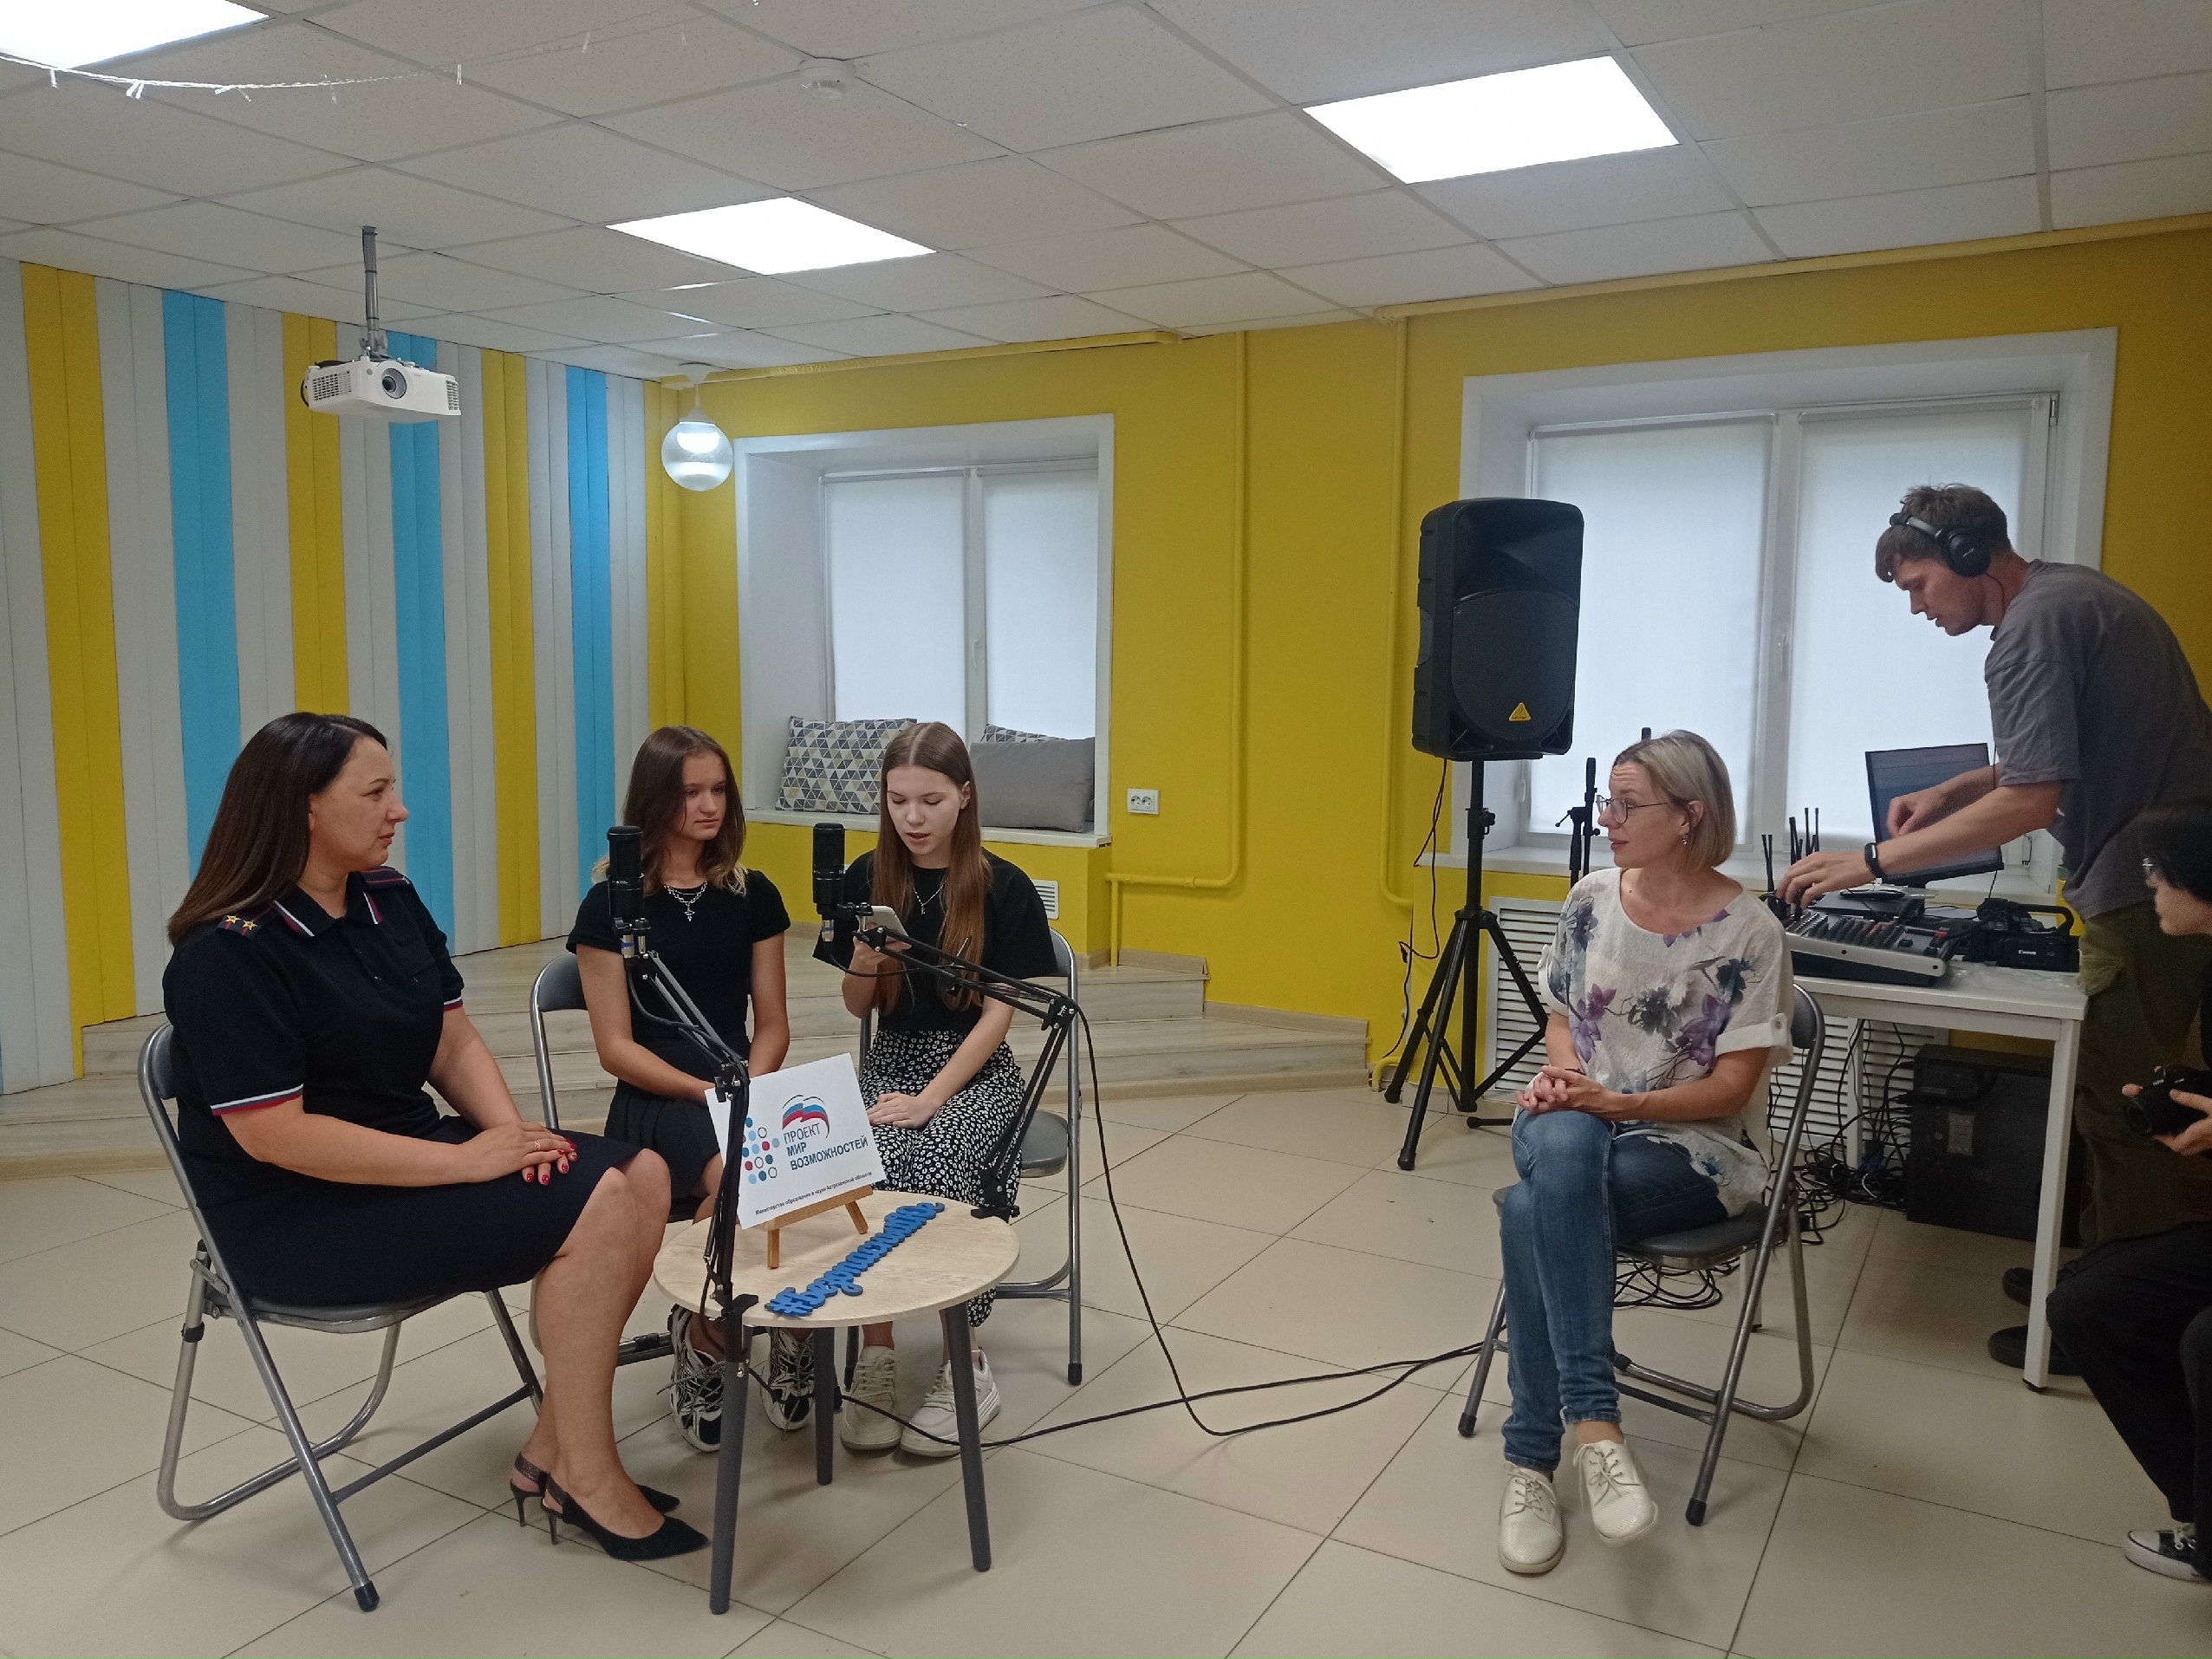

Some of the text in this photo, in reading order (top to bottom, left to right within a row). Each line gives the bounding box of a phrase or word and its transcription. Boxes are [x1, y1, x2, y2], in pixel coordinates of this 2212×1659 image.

[784, 1122, 821, 1144] ПРОЕКТ
[786, 1142, 807, 1157] МИР
[790, 1135, 869, 1170] ВОЗМОЖНОСТЕЙ
